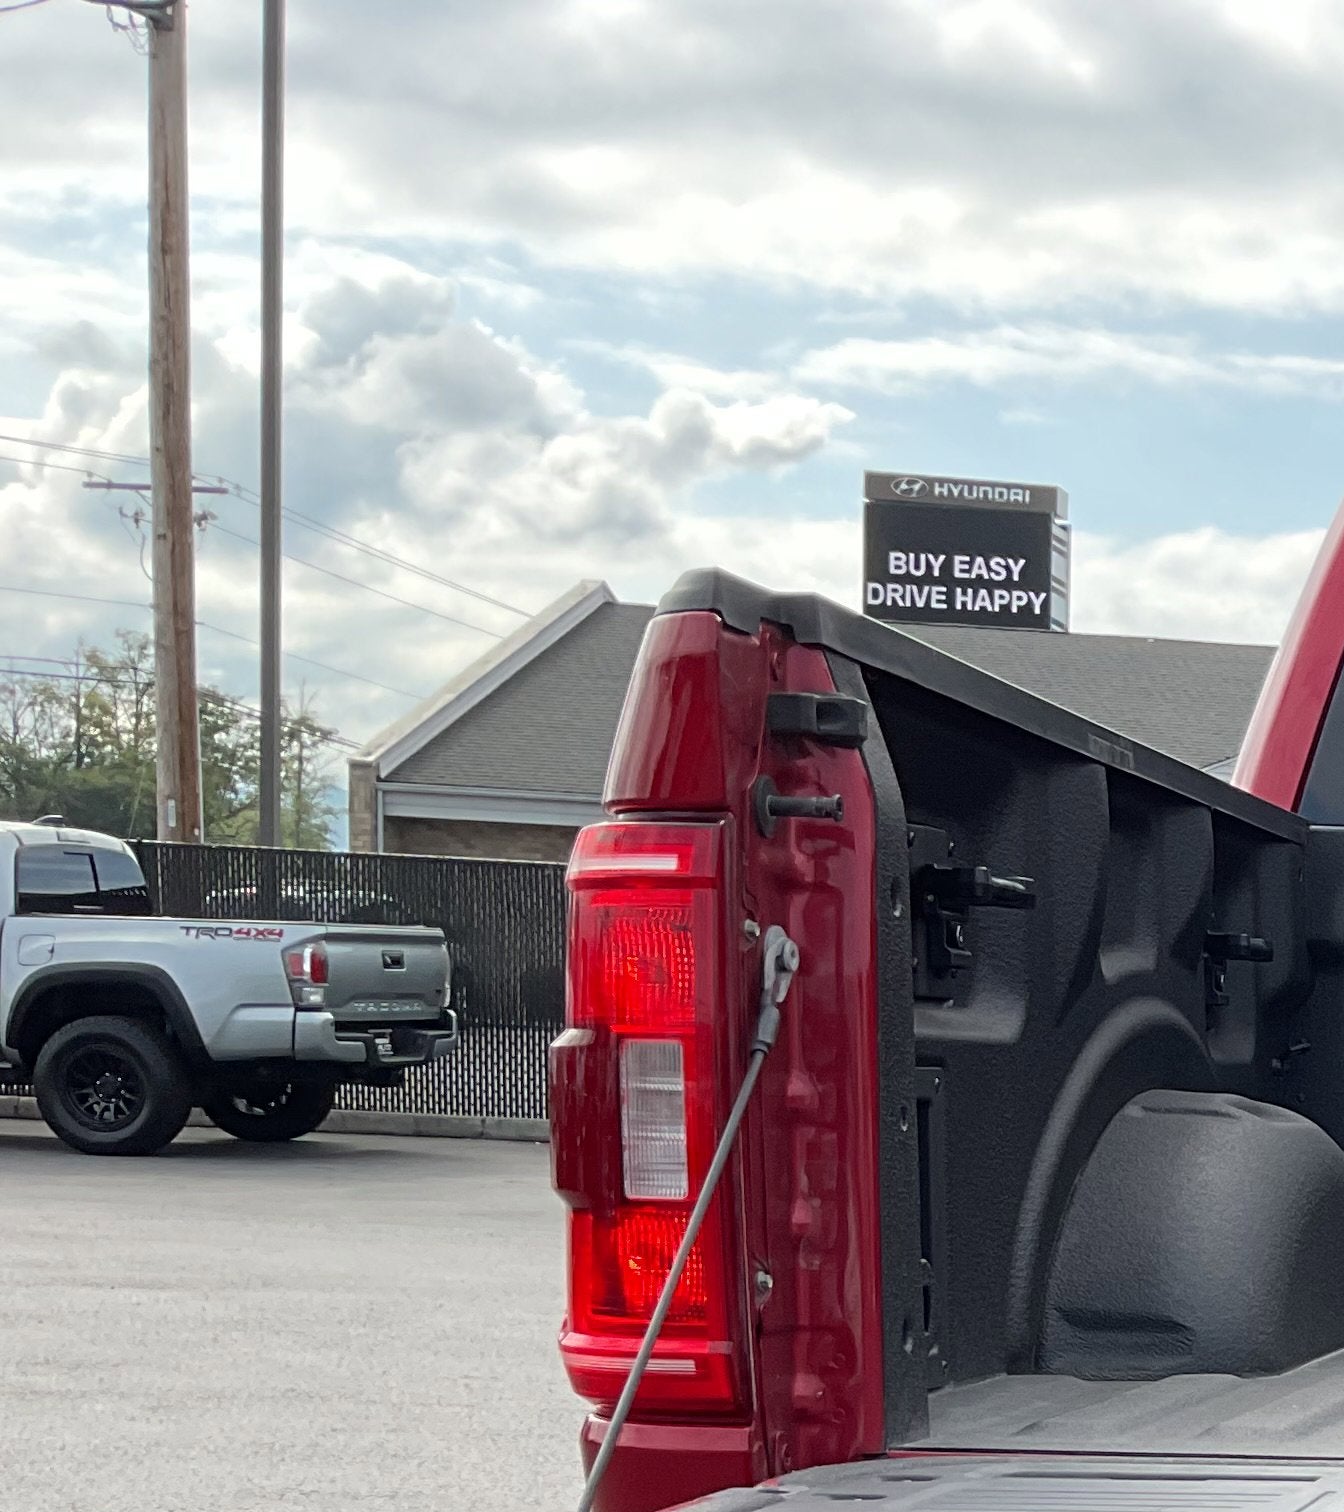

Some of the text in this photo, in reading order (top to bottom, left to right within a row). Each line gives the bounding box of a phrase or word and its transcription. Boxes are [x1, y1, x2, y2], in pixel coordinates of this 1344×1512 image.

[934, 482, 1030, 504] HYUNDAI
[888, 551, 1026, 582] BUY EASY
[866, 581, 1047, 615] DRIVE HAPPY
